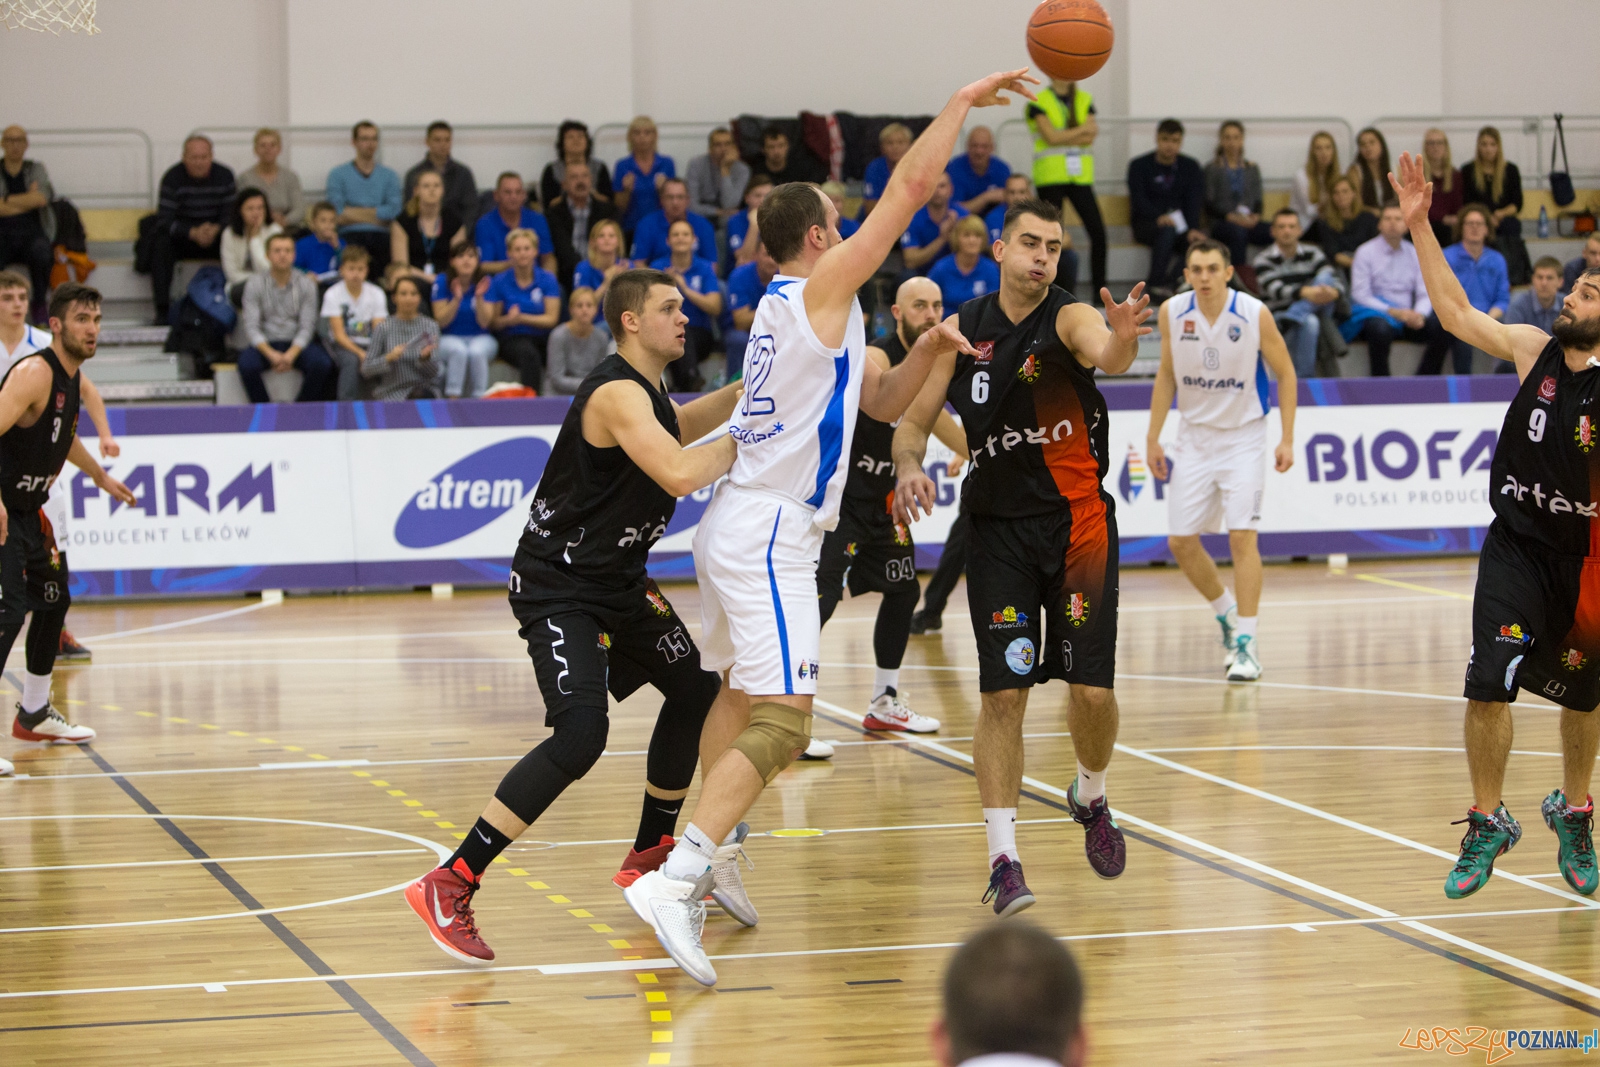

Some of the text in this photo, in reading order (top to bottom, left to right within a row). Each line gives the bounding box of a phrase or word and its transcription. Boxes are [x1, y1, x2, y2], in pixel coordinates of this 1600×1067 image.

[1203, 347, 1220, 370] 8
[971, 371, 990, 404] 6
[51, 417, 61, 443] 3
[1527, 408, 1547, 442] 9
[416, 473, 524, 510] atrem
[1334, 490, 1398, 507] POLSKI
[66, 523, 250, 546] ODUCENT LEKÓW
[886, 556, 914, 582] 84
[44, 581, 60, 603] 3
[656, 626, 691, 663] 15
[1062, 640, 1073, 672] 6
